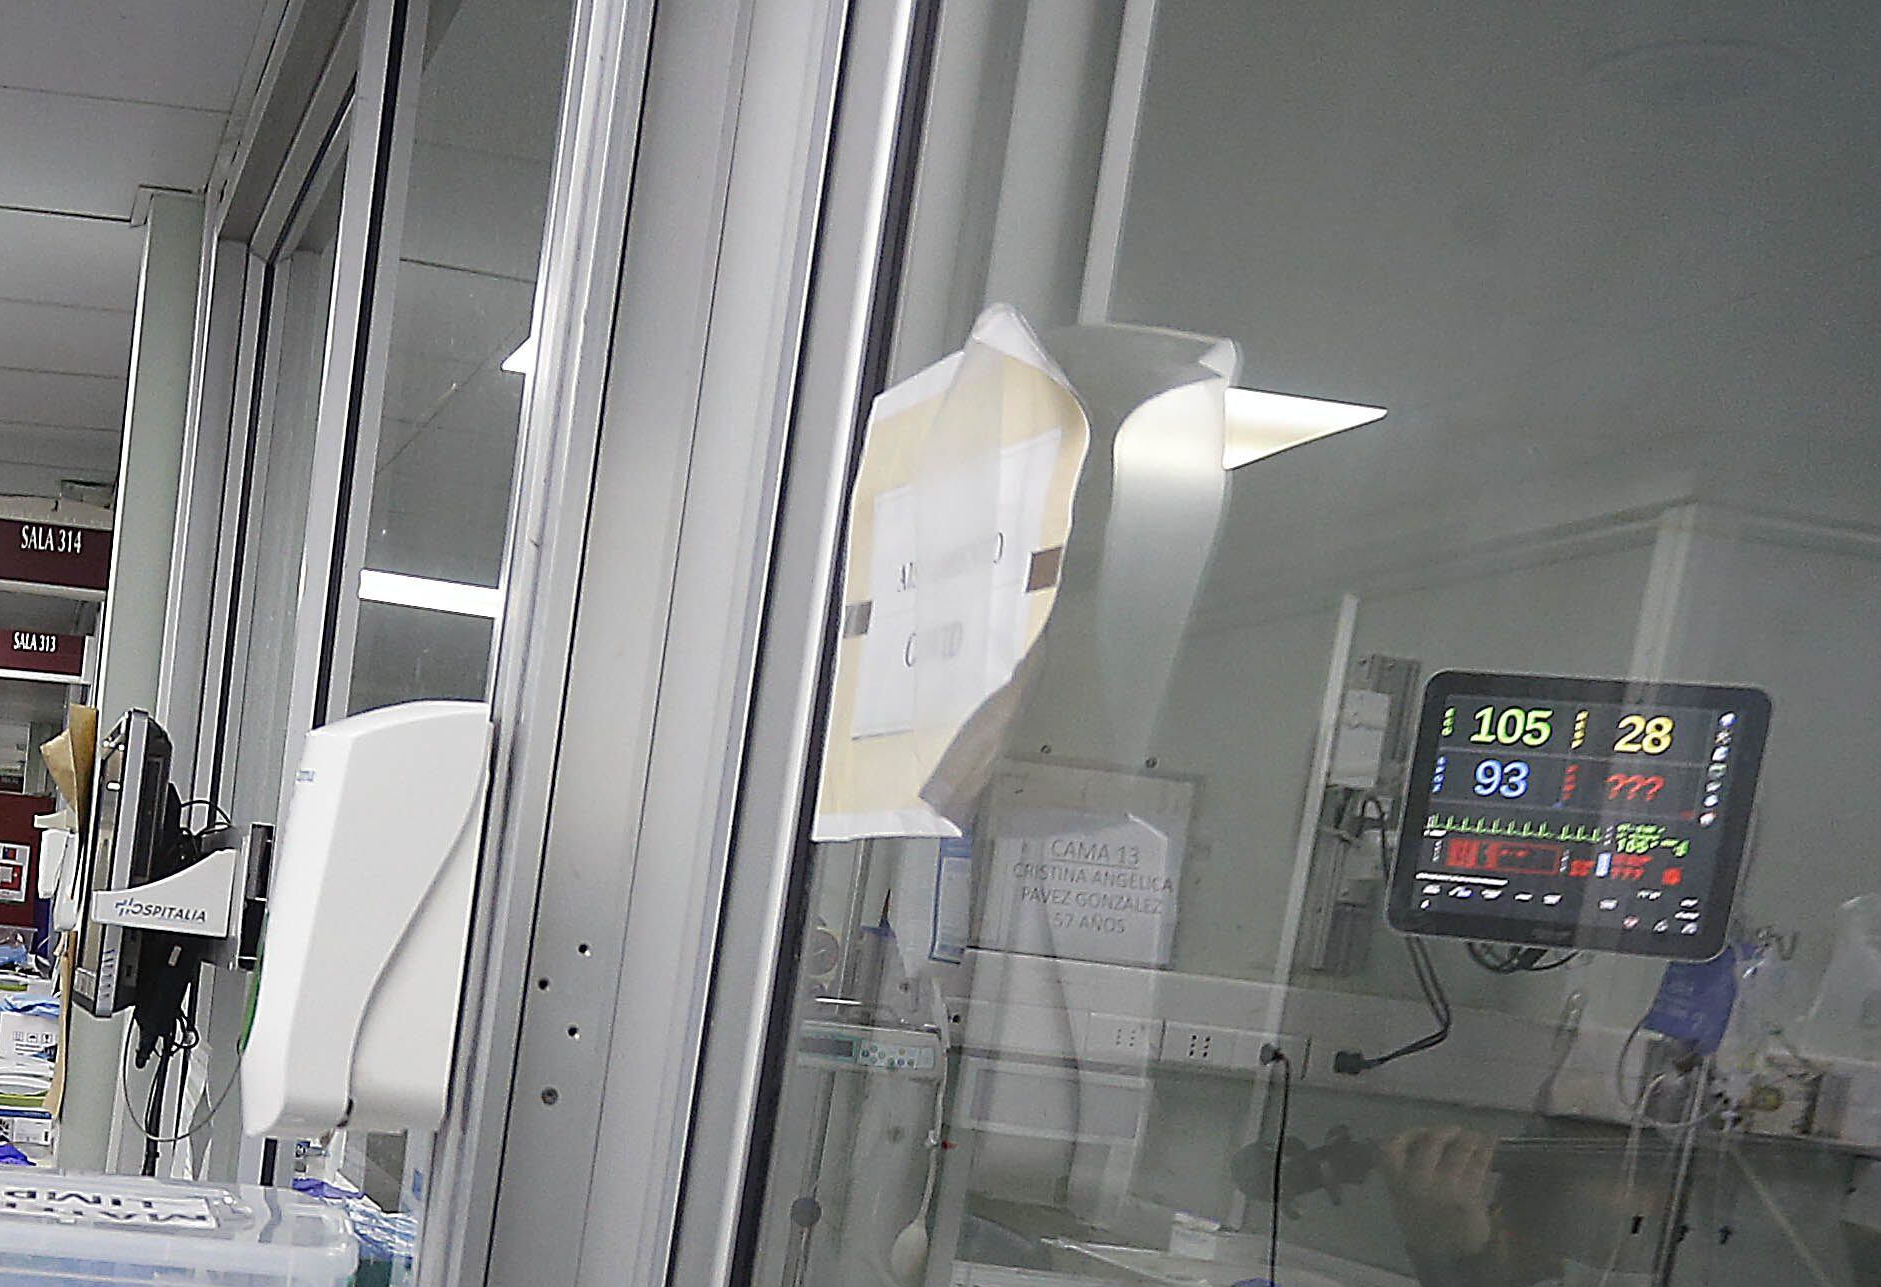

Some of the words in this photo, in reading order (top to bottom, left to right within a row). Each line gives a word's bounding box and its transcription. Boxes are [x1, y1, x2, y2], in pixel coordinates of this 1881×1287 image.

[21, 525, 54, 552] SALA
[58, 529, 82, 553] 314
[13, 632, 36, 650] SALA
[39, 635, 56, 652] 313
[1470, 706, 1553, 746] 105
[1614, 715, 1674, 753] 28
[1474, 759, 1530, 798] 93
[1050, 839, 1110, 862] CAMA
[1118, 844, 1140, 866] 13
[115, 898, 207, 923] HOSPITALIA
